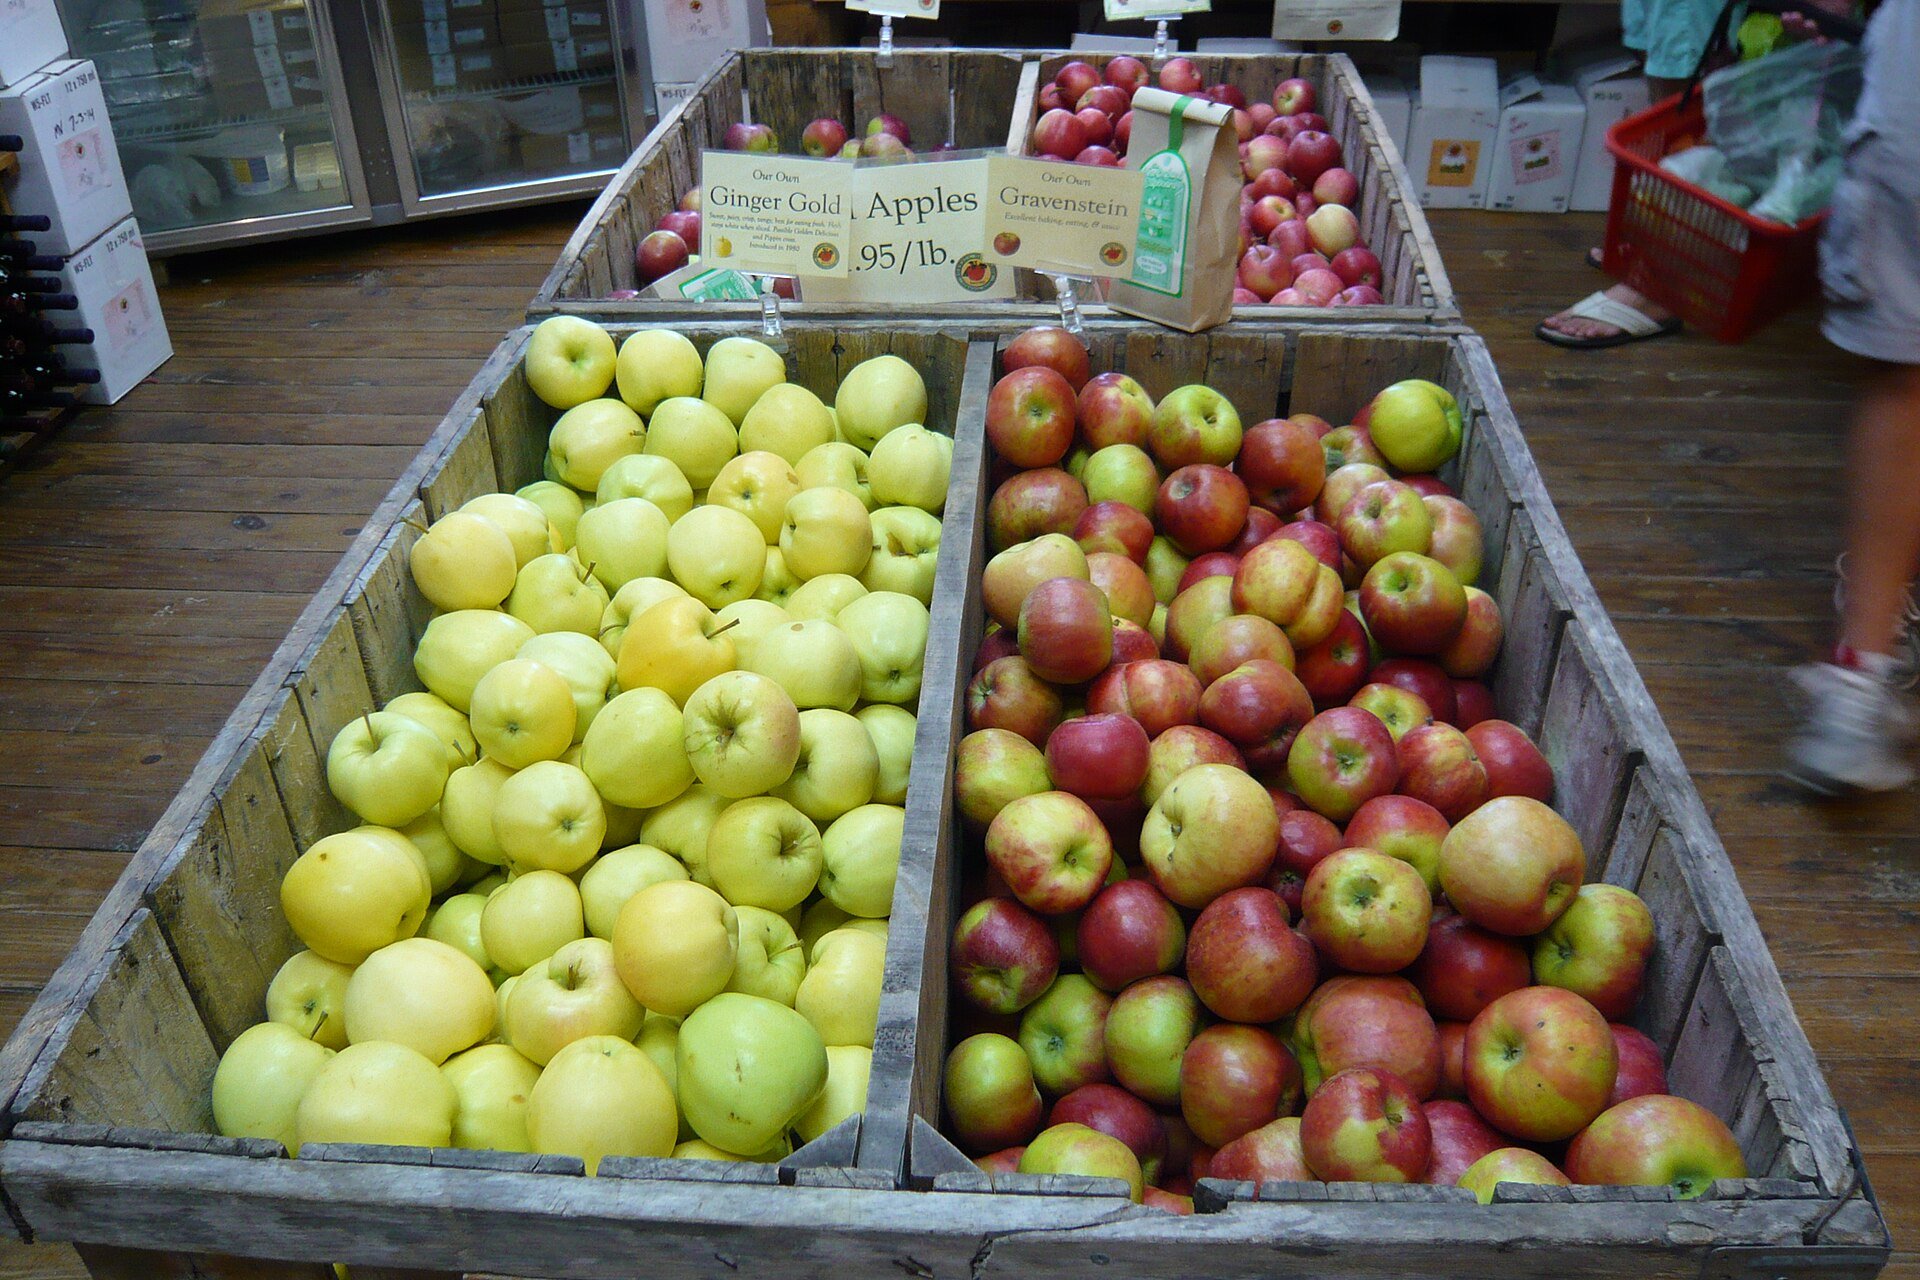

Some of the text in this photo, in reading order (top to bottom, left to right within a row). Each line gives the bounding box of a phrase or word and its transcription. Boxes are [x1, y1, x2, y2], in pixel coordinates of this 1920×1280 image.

[752, 169, 800, 183] Our Own
[1041, 172, 1091, 187] Our Own
[710, 185, 782, 213] Ginger
[788, 192, 840, 215] Gold
[866, 186, 978, 226] Apples
[1000, 186, 1128, 218] Gravenstein
[848, 239, 955, 275] .95/lb.
